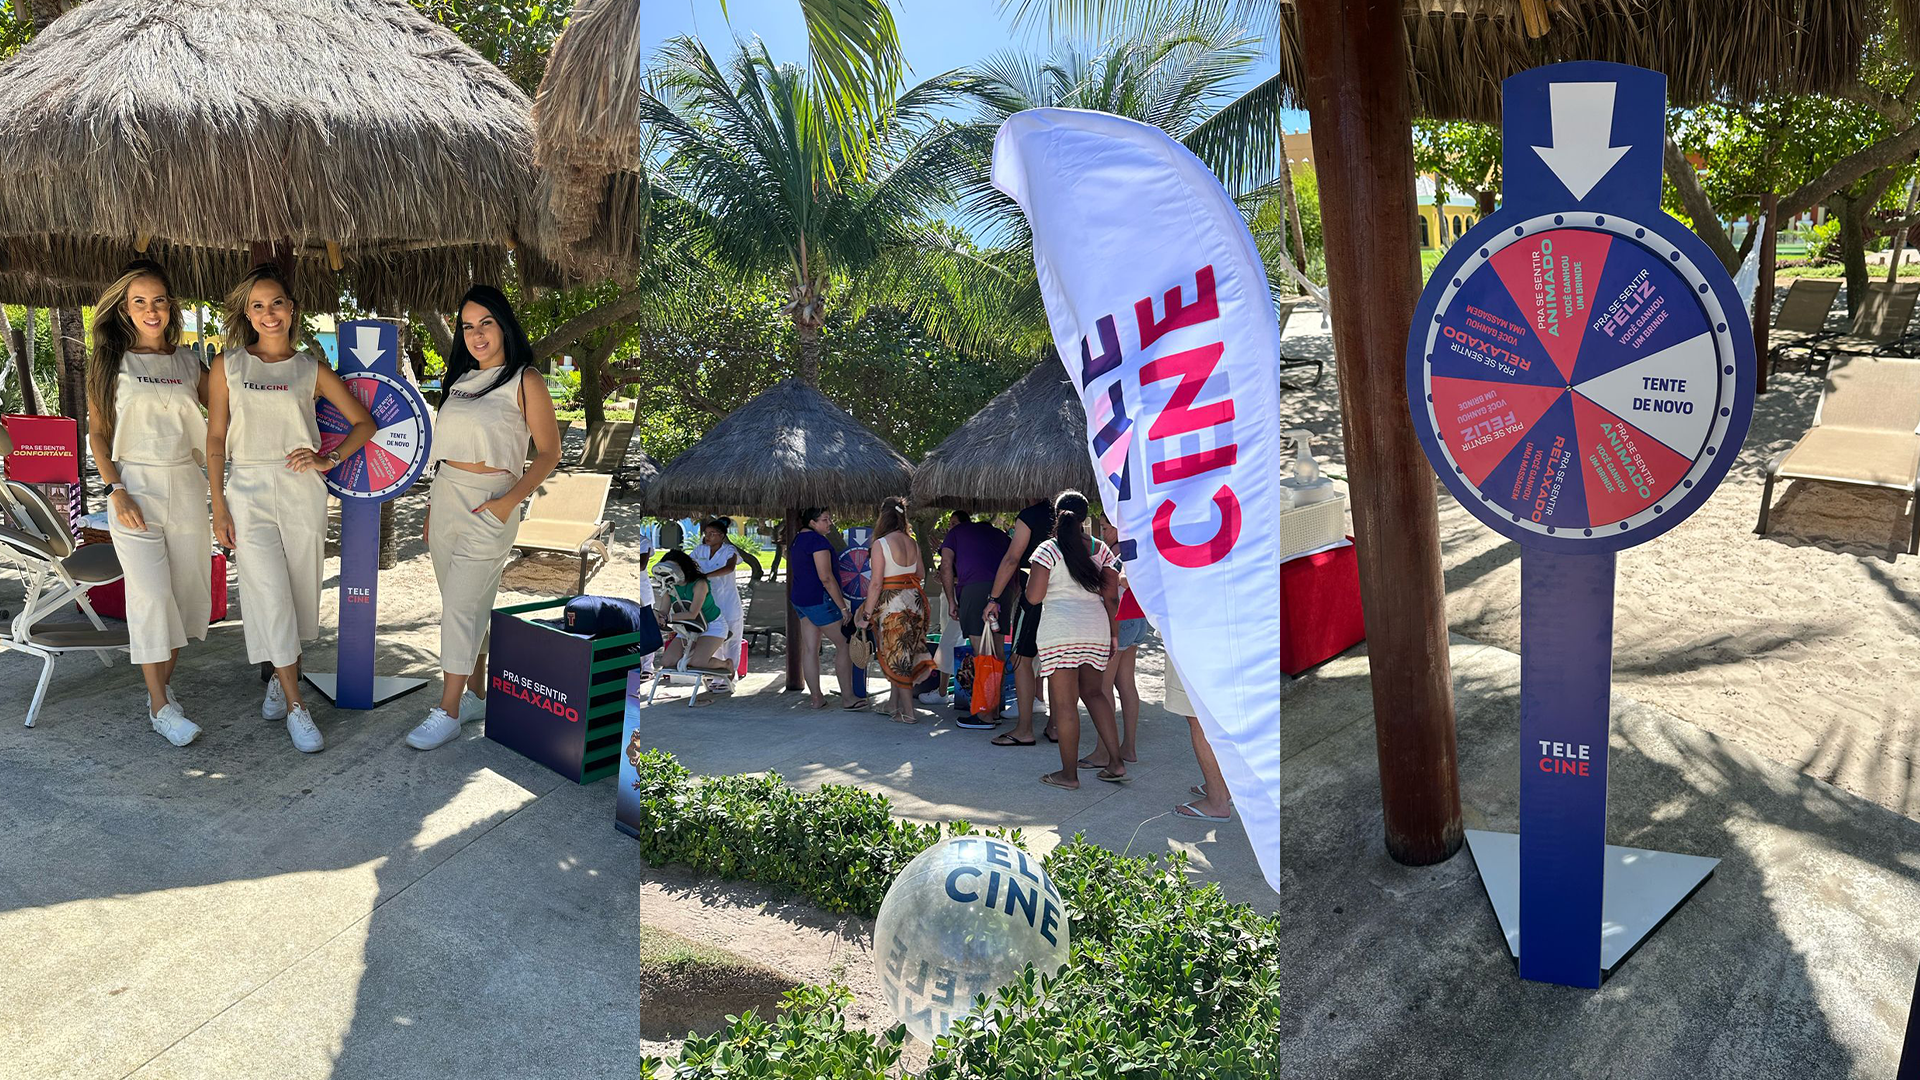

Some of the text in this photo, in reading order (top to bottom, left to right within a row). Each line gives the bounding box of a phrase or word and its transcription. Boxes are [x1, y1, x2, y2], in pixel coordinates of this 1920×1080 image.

[1532, 251, 1546, 329] PRA SE SENTIR
[1541, 239, 1559, 337] ANIMADO
[1561, 256, 1573, 318] VOCÊ GANHOU
[1574, 261, 1584, 310] UM BRINDE
[1593, 268, 1650, 332] PRA SE SENTIR
[1466, 304, 1526, 336] UMA MASSAGEM
[1603, 280, 1656, 338] FELIZ
[1619, 296, 1664, 344] VOCÊ GANHOU
[1443, 326, 1532, 371] RELAXADO
[1466, 318, 1518, 346] VOCÊ GANHOU
[1632, 310, 1669, 348] UM BRINDE
[1450, 342, 1516, 376] PRA SE SENTIR
[137, 376, 183, 385] TELECINE
[244, 382, 289, 391] TELECINE
[1642, 376, 1687, 392] TENTE
[376, 397, 395, 418] FELIZ
[1134, 264, 1242, 568] CINE
[1457, 399, 1508, 424] VOCÊ GANHOU
[1458, 390, 1497, 411] UM BRINDE
[1633, 398, 1694, 414] DE NOVO
[1460, 411, 1517, 442] FELIZ
[1461, 422, 1524, 452] PRA SE SENTIR
[1511, 442, 1534, 500] UMA MASSAGEM
[1589, 454, 1615, 493] UM BRINDE
[1596, 443, 1628, 493] VOCÊ GANHOU
[1600, 423, 1651, 499] ANIMADO
[1616, 423, 1656, 486] PRA SE SENTIR
[1522, 450, 1544, 501] VOCÊ GANHOU
[1532, 435, 1565, 523] RELAXADO
[1545, 451, 1571, 516] PRA SE SENTIR
[347, 587, 369, 595] TELE
[348, 596, 369, 604] CINE
[567, 611, 576, 627] T
[493, 676, 579, 723] RELAXADO
[503, 669, 568, 704] PRA SE SENTIR
[1539, 740, 1590, 760] TELE
[1539, 757, 1590, 777] CINE
[950, 840, 1060, 904] TELE
[945, 867, 1060, 947] CINE
